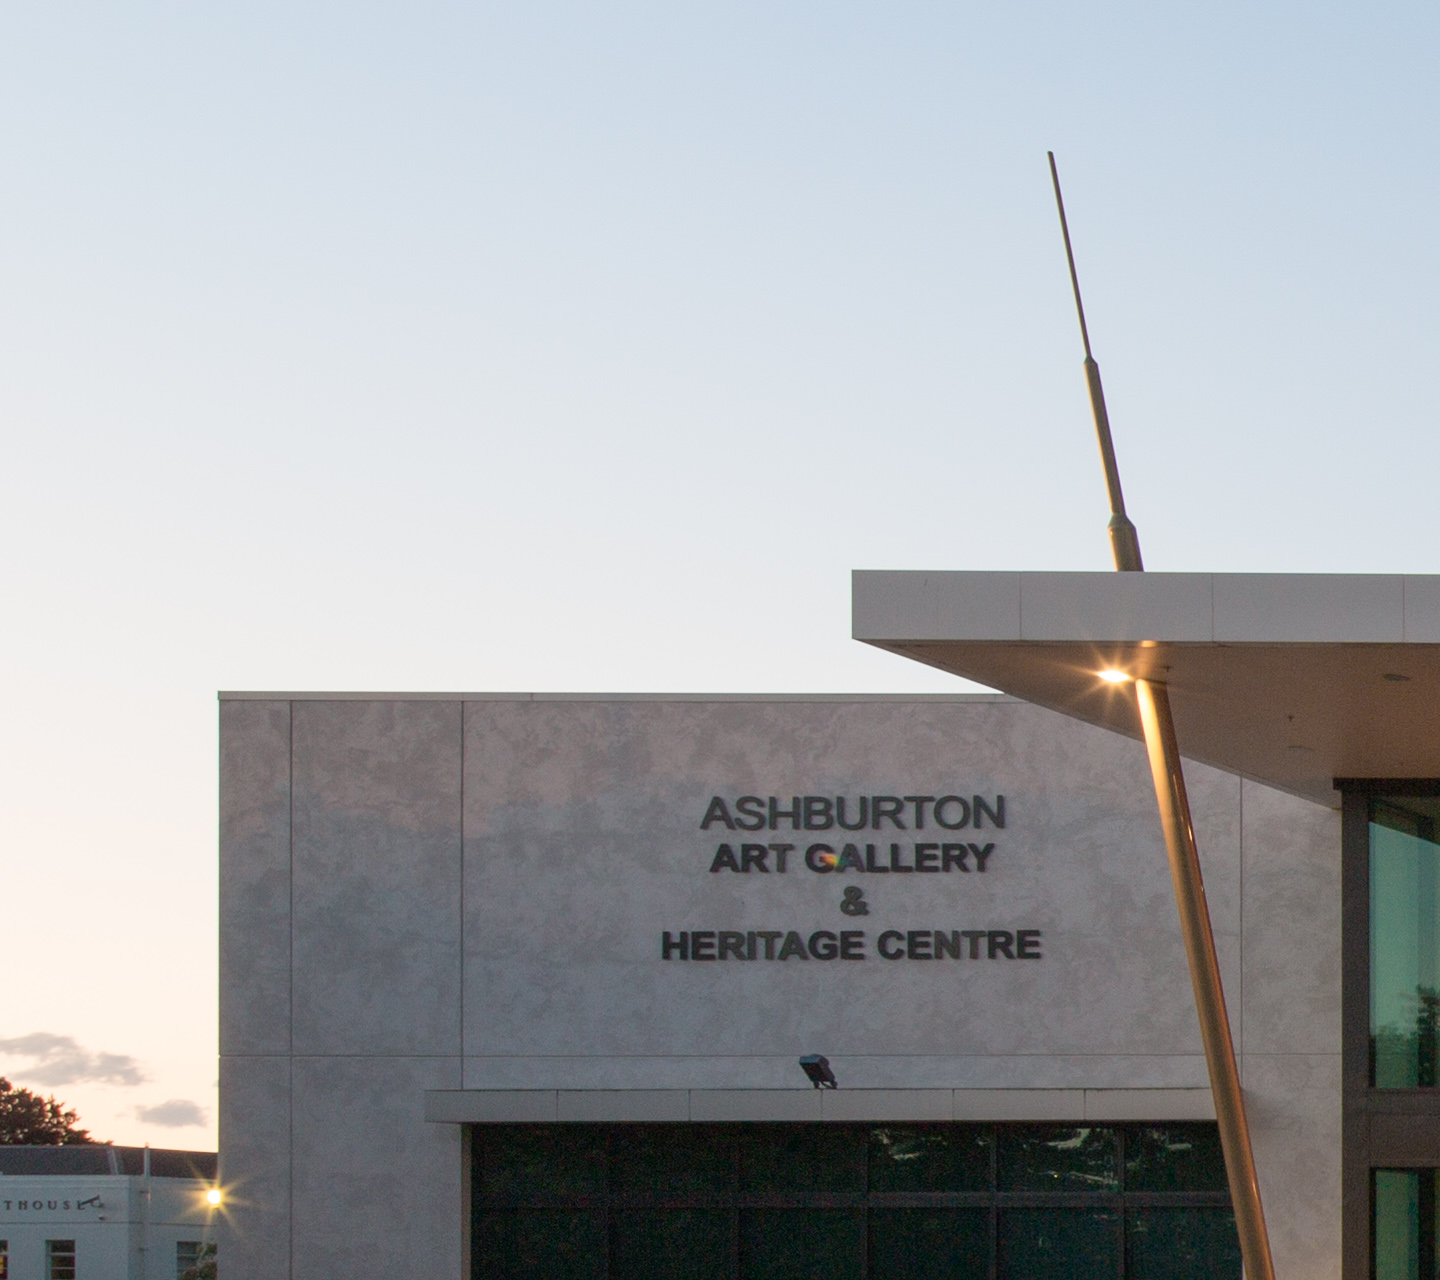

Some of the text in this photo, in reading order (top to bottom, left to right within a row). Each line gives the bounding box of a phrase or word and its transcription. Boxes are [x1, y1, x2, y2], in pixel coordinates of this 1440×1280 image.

[700, 795, 1006, 831] ASHBURTON
[709, 843, 995, 874] ART GALLERY
[839, 885, 869, 917] &
[661, 930, 1042, 961] HERITAGE CENTRE
